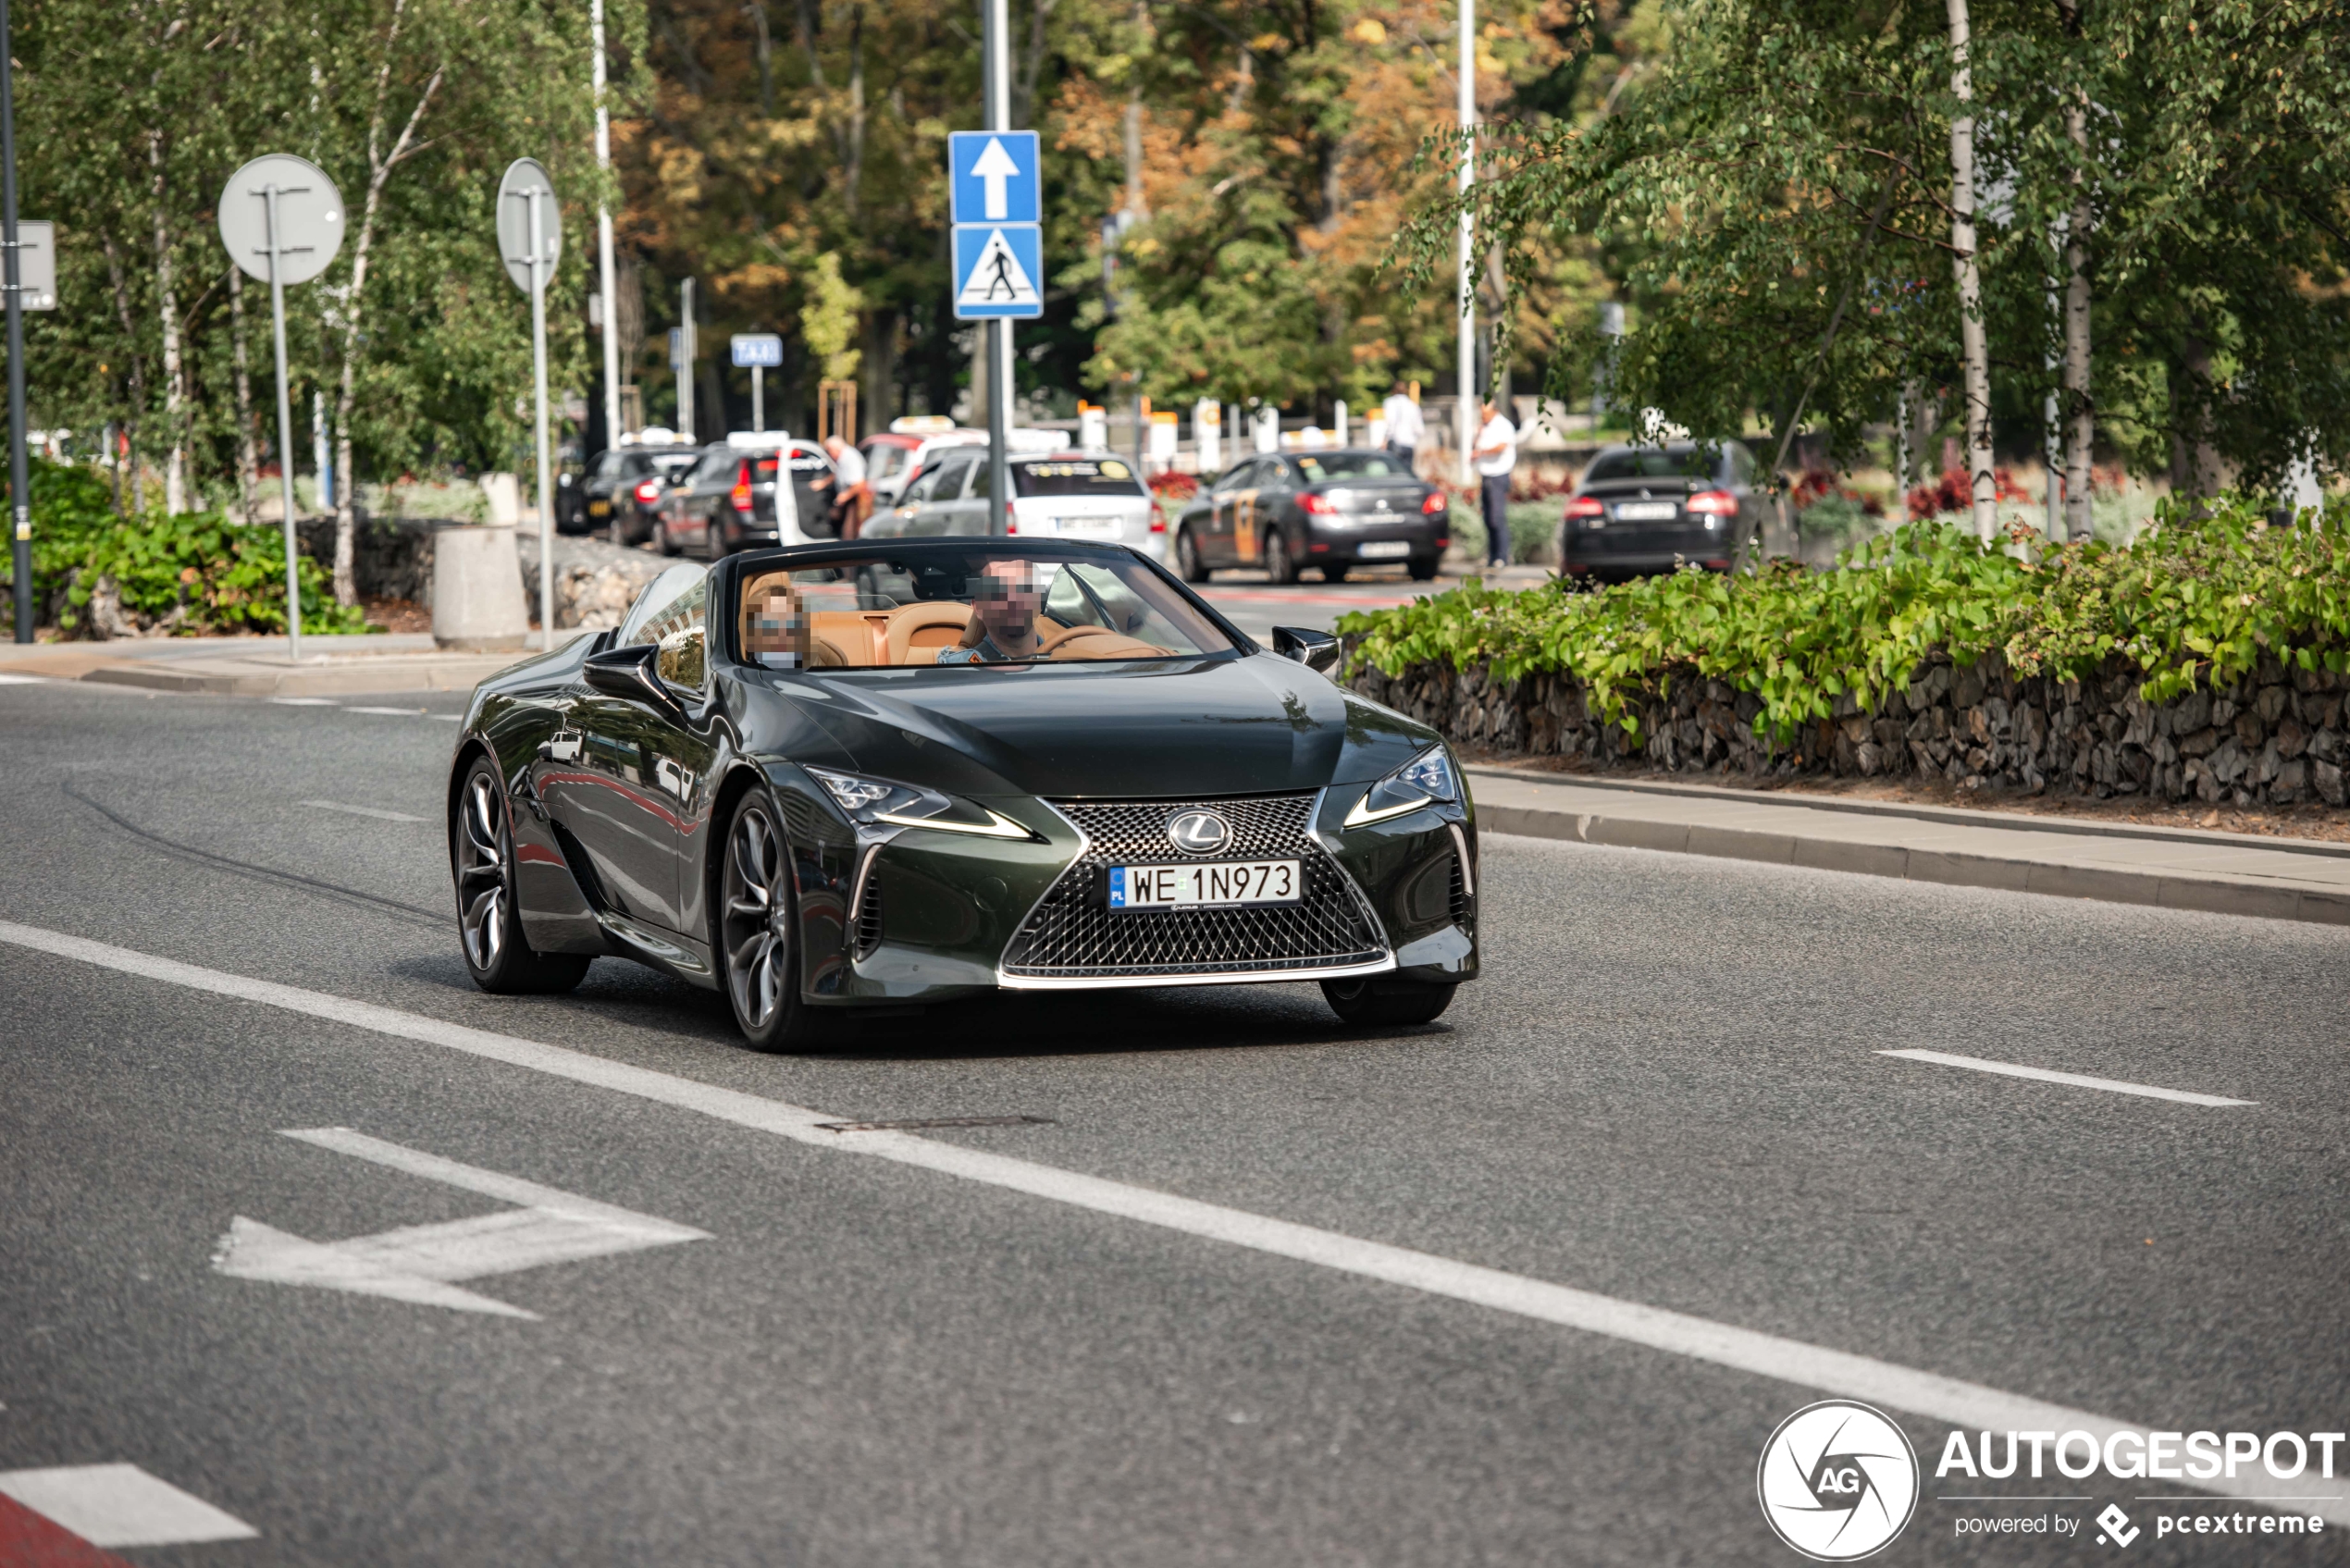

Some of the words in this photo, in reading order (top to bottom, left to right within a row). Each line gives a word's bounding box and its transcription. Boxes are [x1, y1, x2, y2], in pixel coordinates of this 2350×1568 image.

[1111, 891, 1124, 901] PL
[1133, 869, 1175, 903] WE
[1193, 865, 1292, 901] 1N973
